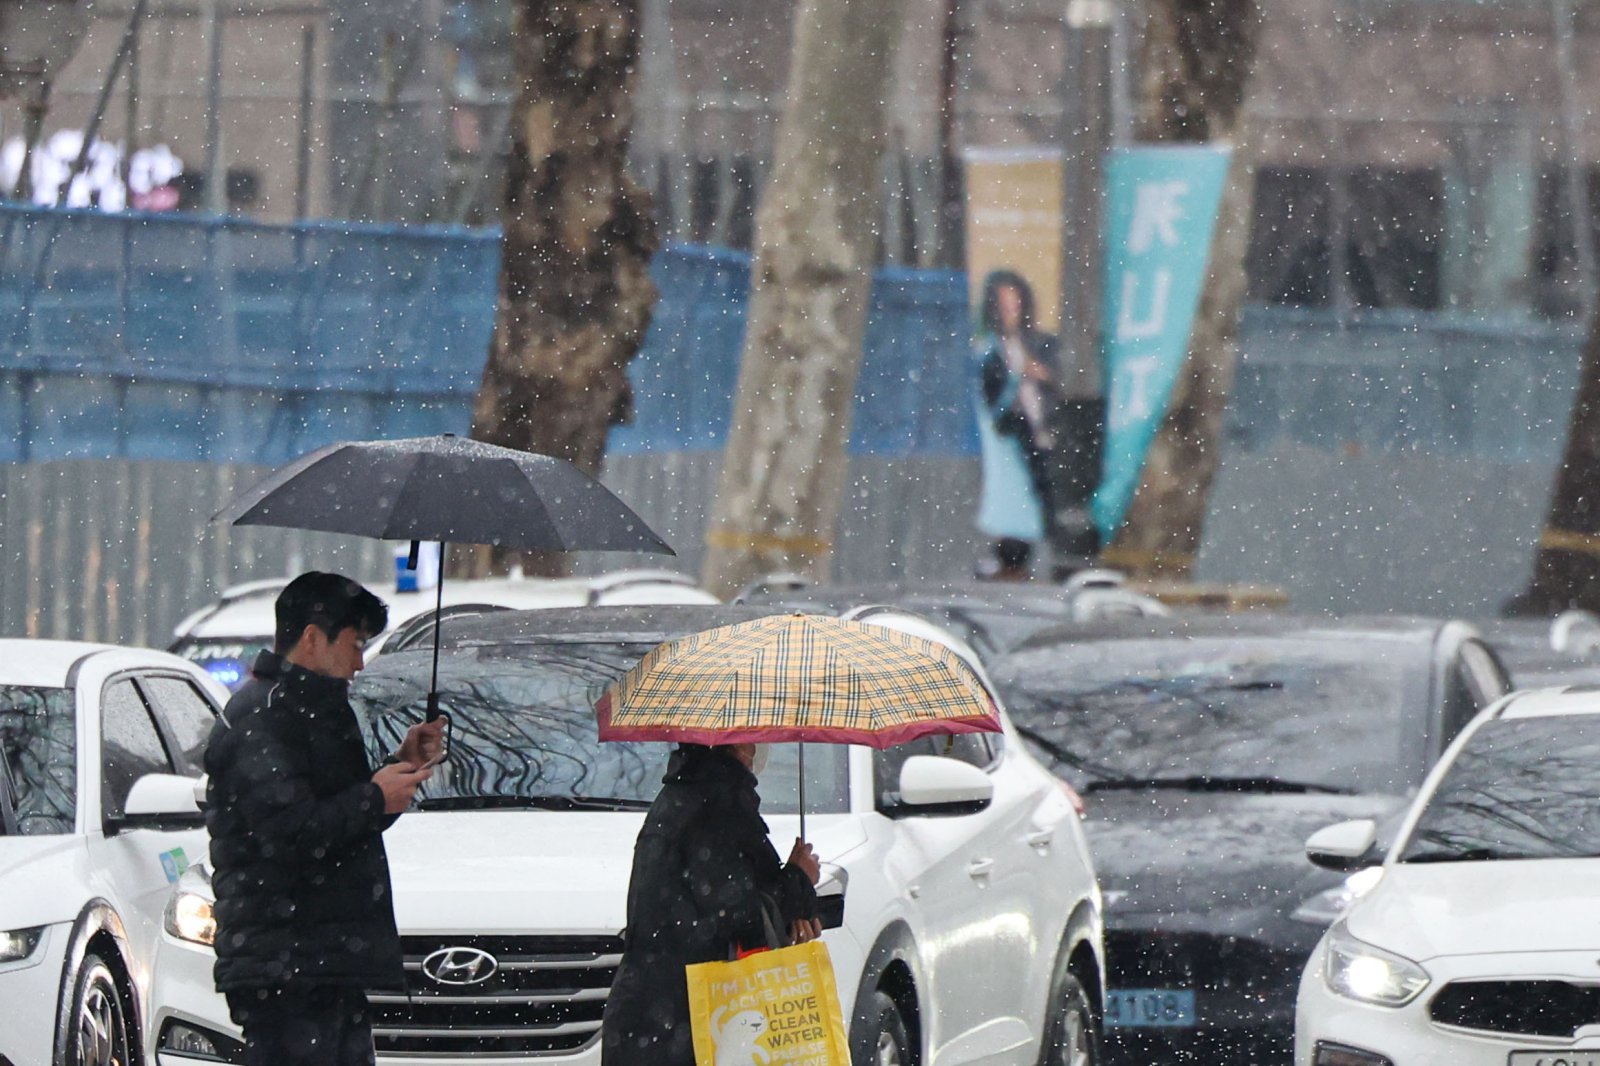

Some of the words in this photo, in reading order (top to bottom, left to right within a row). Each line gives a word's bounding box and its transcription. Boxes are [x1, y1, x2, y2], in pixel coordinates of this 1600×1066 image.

[712, 980, 739, 1000] I'M
[745, 962, 811, 993] LITTLE
[781, 981, 816, 998] AND
[765, 1004, 770, 1018] I
[773, 996, 818, 1016] LOVE
[769, 1012, 821, 1032] CLEAN
[767, 1026, 827, 1049] WATER.
[773, 1040, 826, 1062] PLEASE
